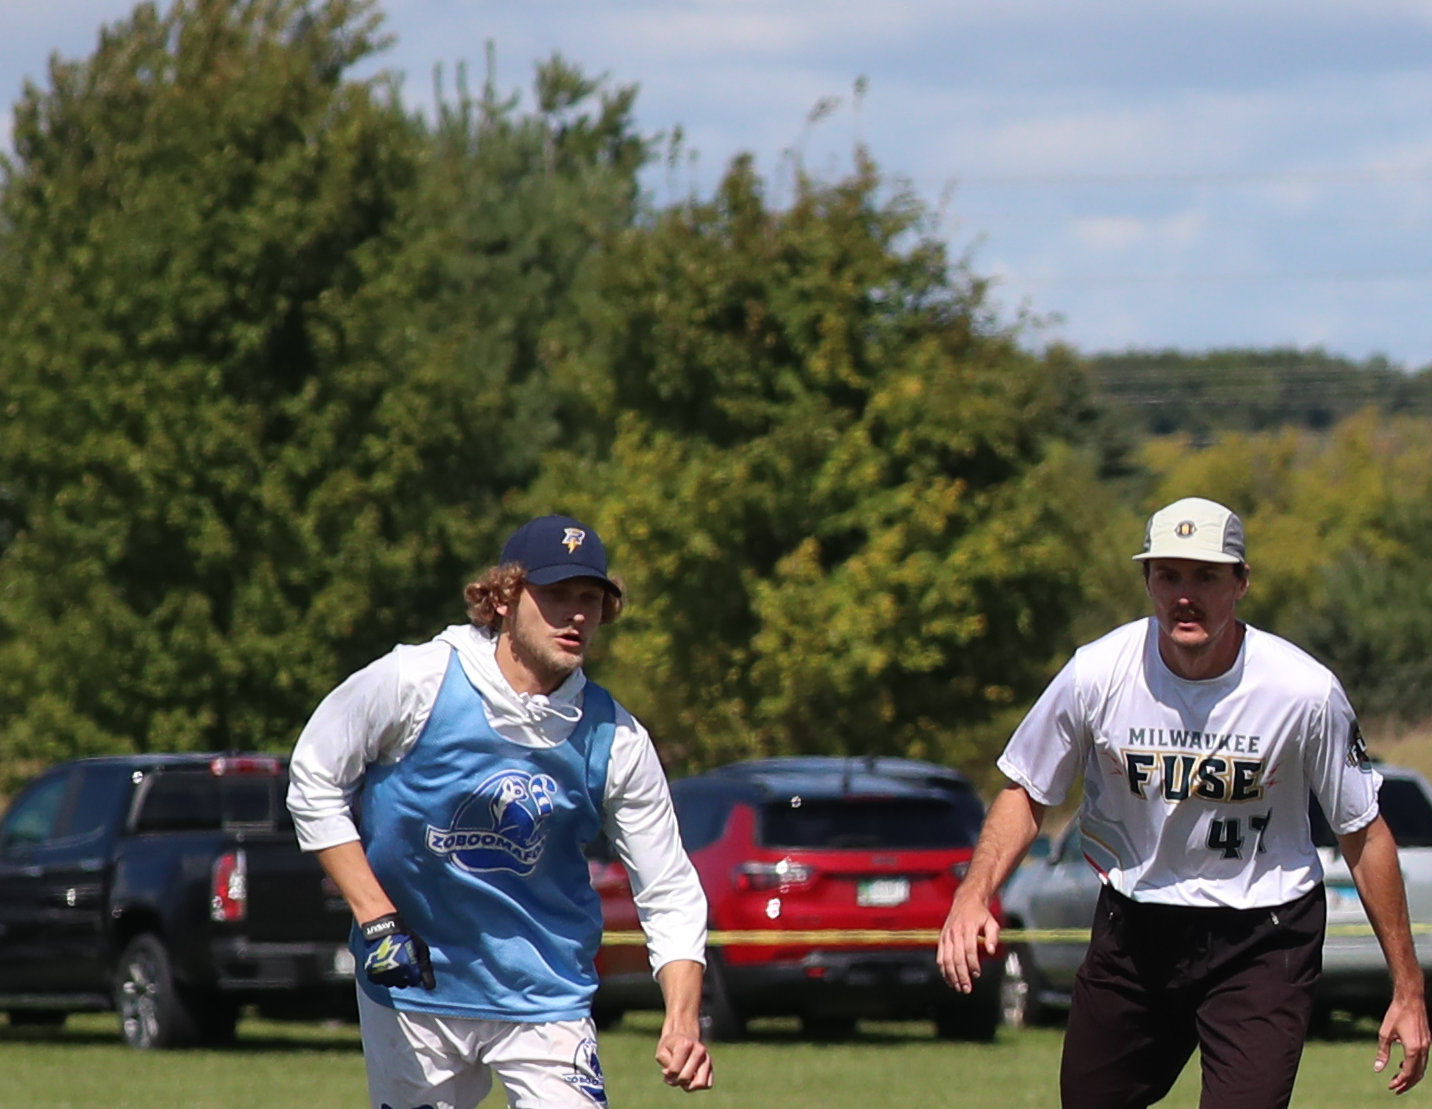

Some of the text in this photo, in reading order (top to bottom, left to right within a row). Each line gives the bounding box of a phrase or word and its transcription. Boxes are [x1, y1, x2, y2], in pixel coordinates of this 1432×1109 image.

[1128, 727, 1260, 753] MILWAUKEE
[1121, 748, 1265, 803] FUSE
[1207, 808, 1272, 860] 47
